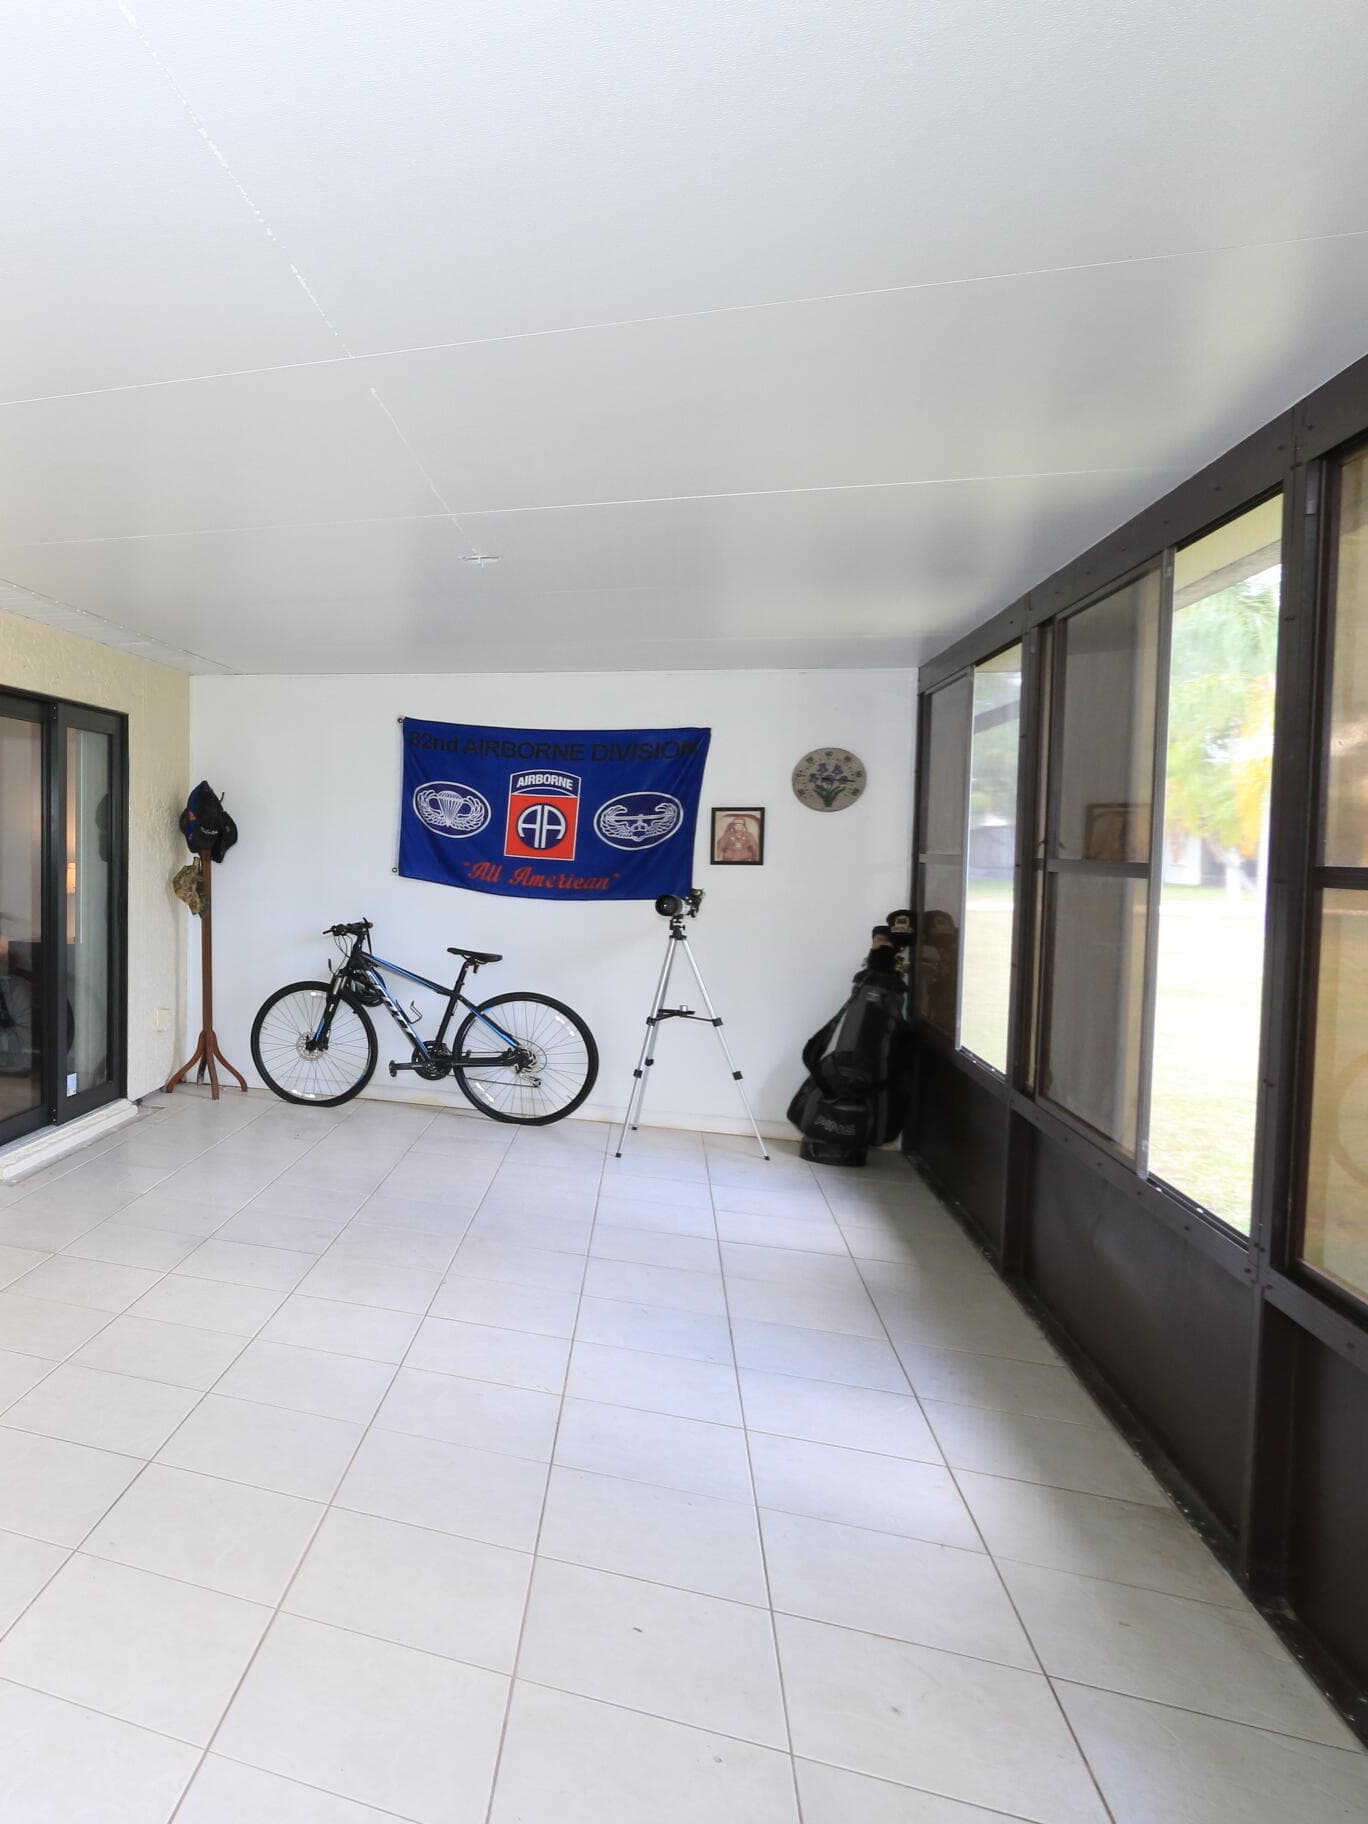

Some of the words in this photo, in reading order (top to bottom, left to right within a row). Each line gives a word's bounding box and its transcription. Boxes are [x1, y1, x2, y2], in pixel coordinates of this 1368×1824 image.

[409, 731, 459, 752] 82nd
[464, 739, 584, 761] AIRBORNE
[592, 738, 698, 761] DIVISION
[517, 773, 574, 791] AIRBORNE
[517, 804, 567, 849] AA
[509, 866, 620, 890] American"
